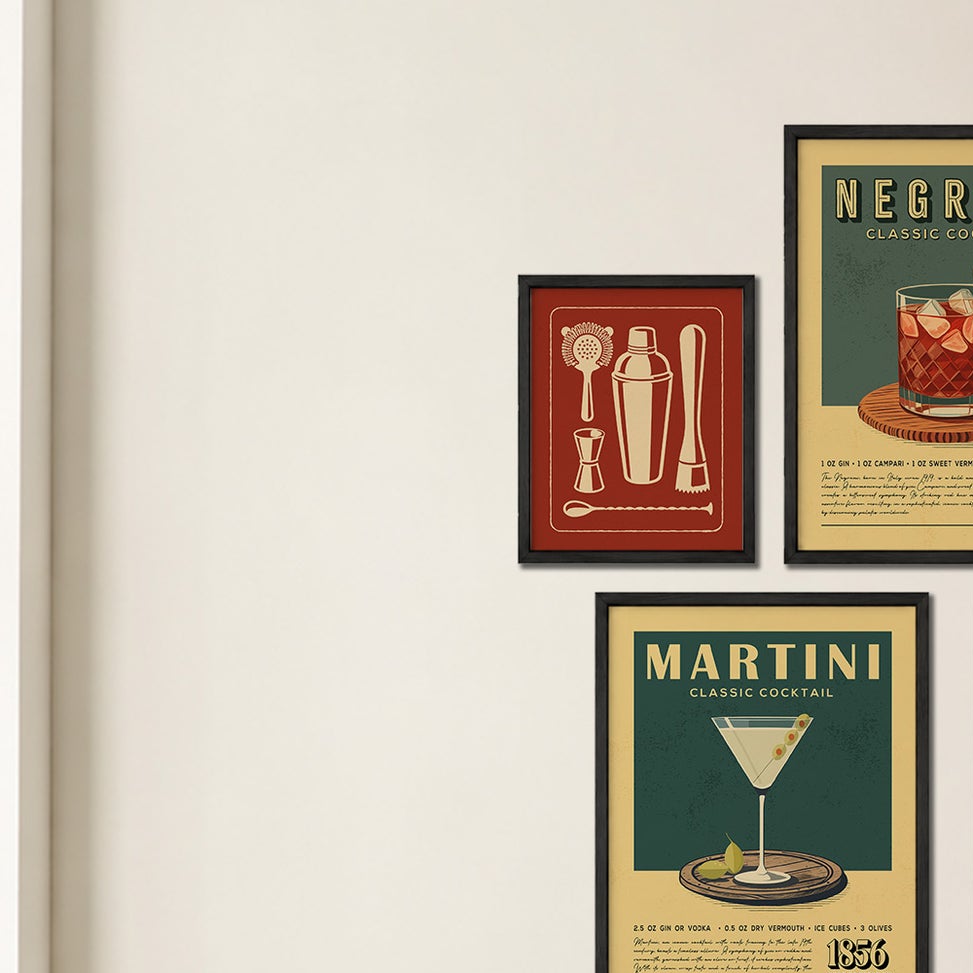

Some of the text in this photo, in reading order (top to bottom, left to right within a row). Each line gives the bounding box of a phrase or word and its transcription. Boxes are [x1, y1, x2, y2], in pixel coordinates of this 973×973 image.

[866, 228, 940, 240] CLASSIC
[647, 643, 880, 680] MARTINI
[690, 688, 834, 698] CLASSIC COCKTAIL
[826, 938, 890, 970] 1856
